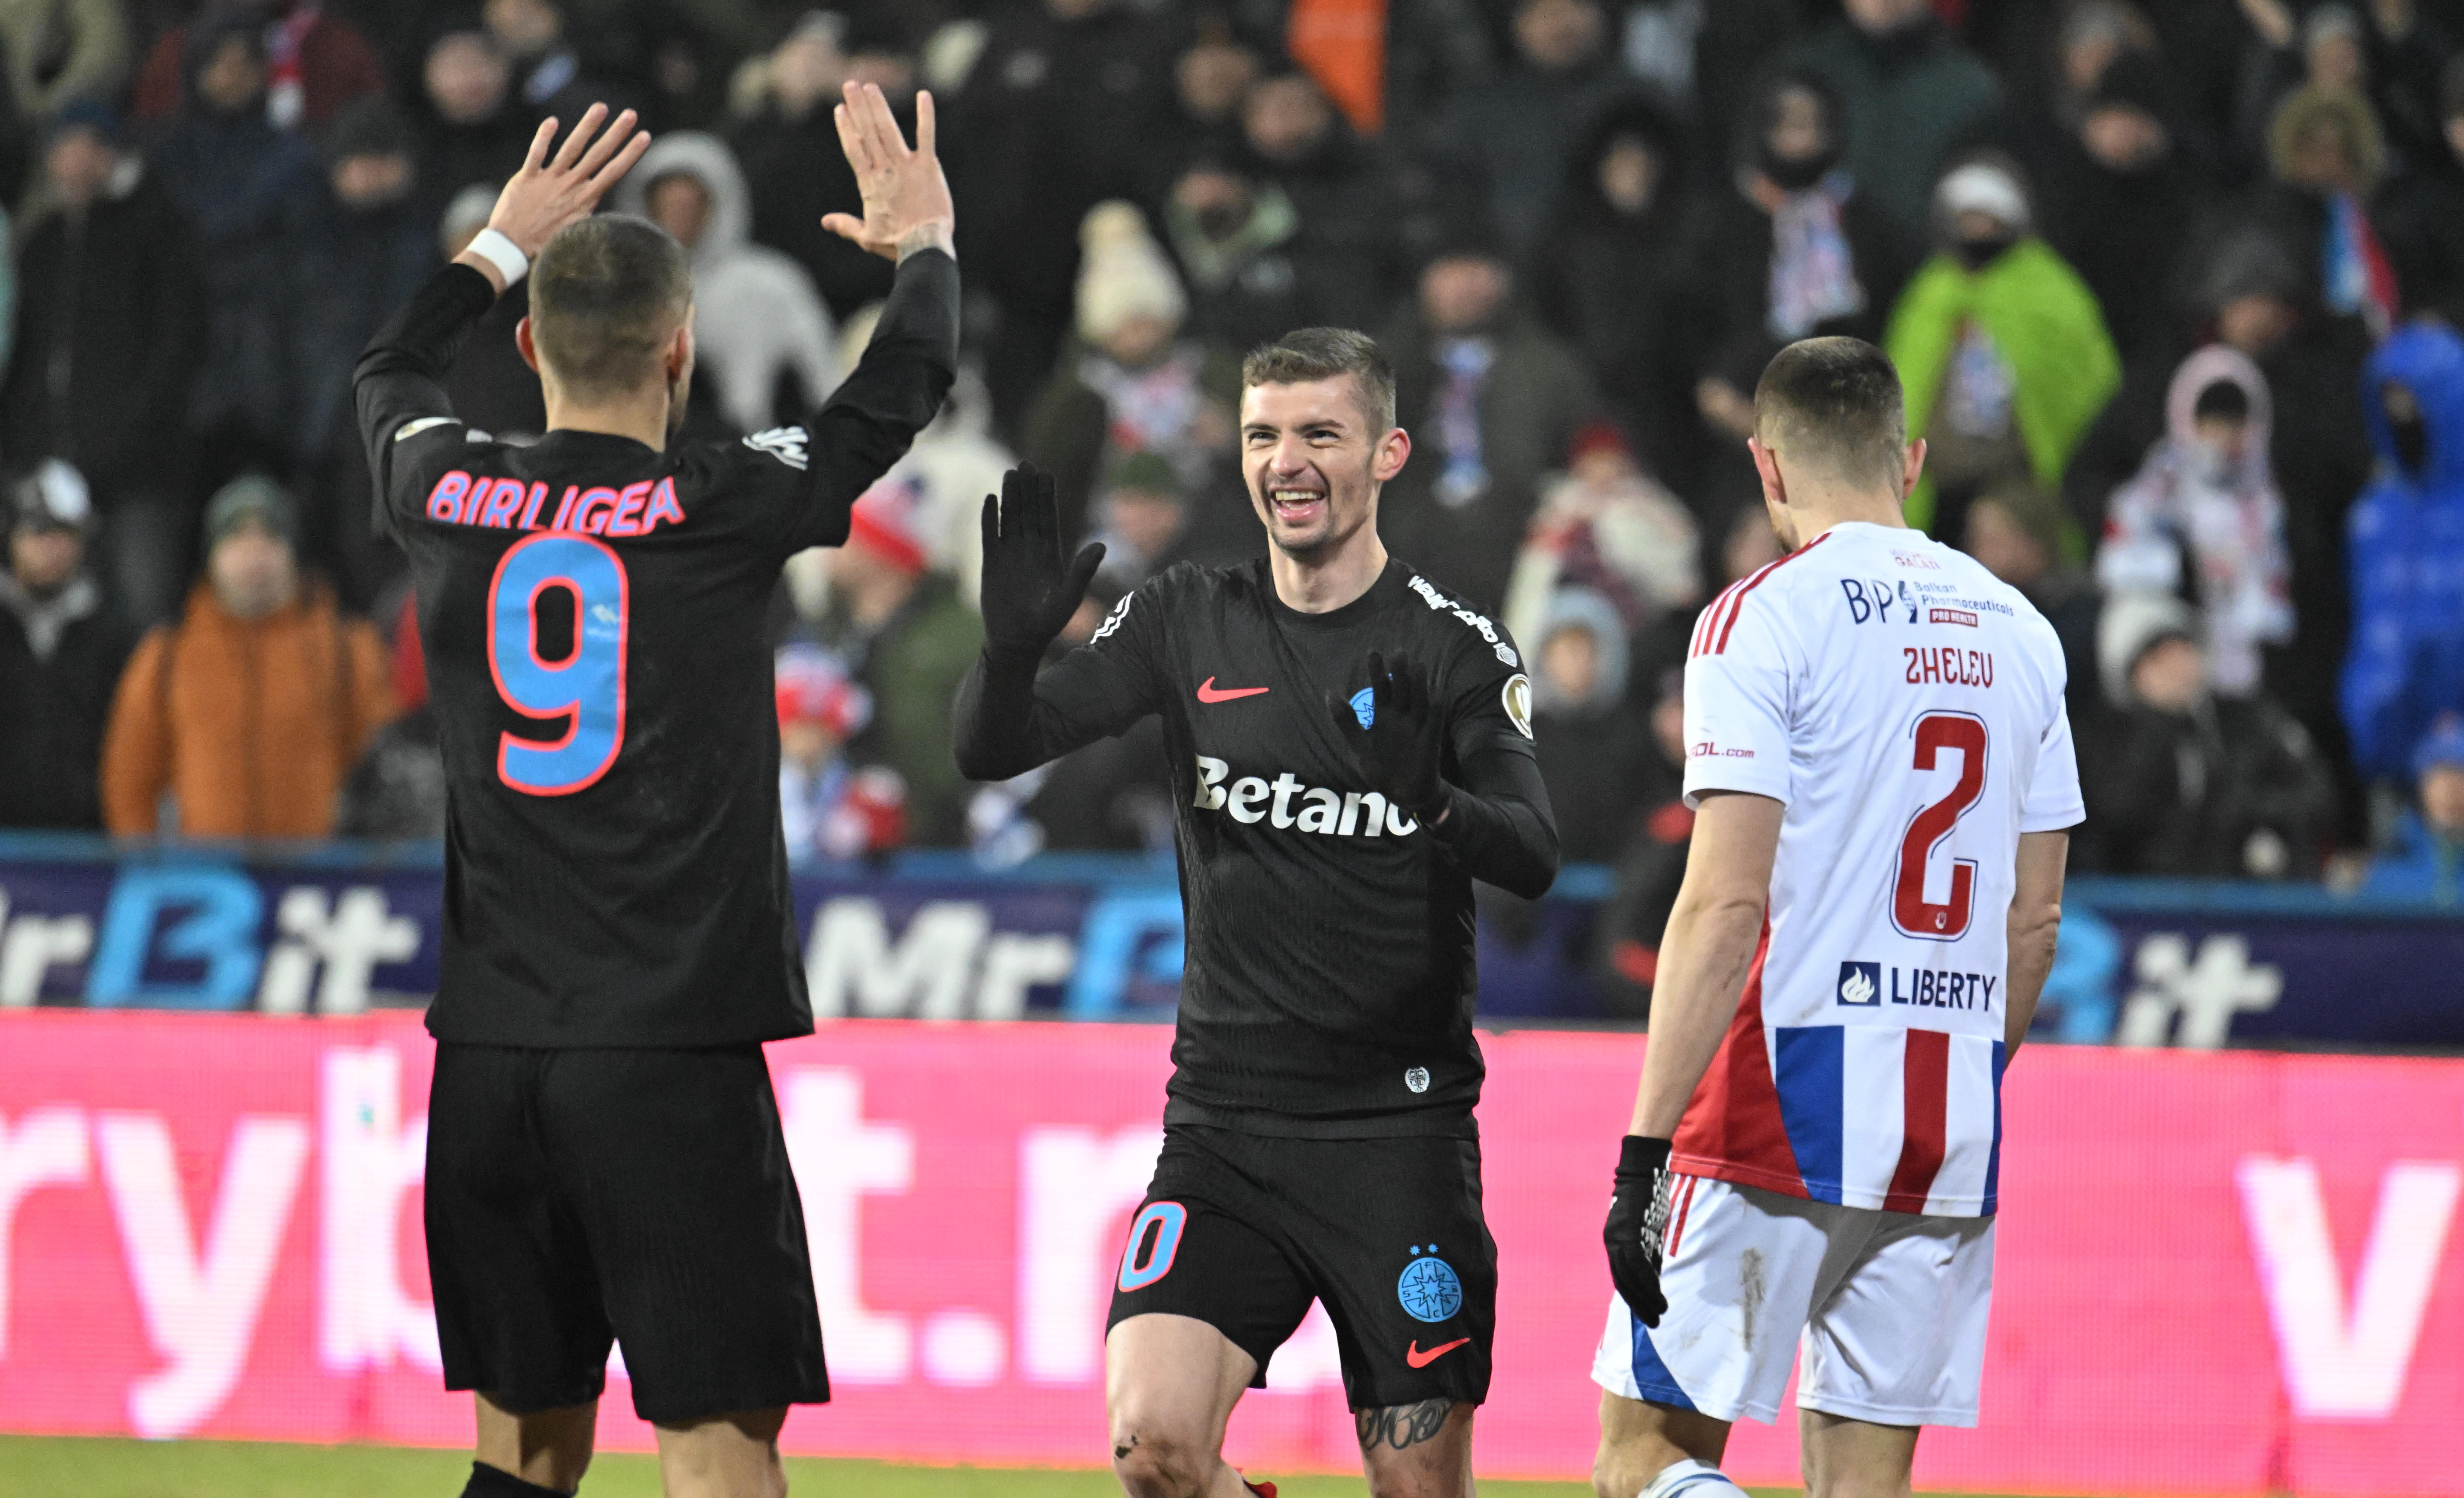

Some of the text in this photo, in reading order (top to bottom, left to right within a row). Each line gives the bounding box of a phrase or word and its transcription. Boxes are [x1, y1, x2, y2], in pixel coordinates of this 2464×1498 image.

[426, 470, 686, 537] BIRLIGEA
[1913, 581, 1958, 593] Balkan
[1921, 594, 2014, 617] Pharmaceuticals
[487, 529, 629, 797] 9
[1890, 709, 1990, 942] 2
[0, 864, 422, 1014] rBit
[1891, 967, 1996, 1011] LIBERTY
